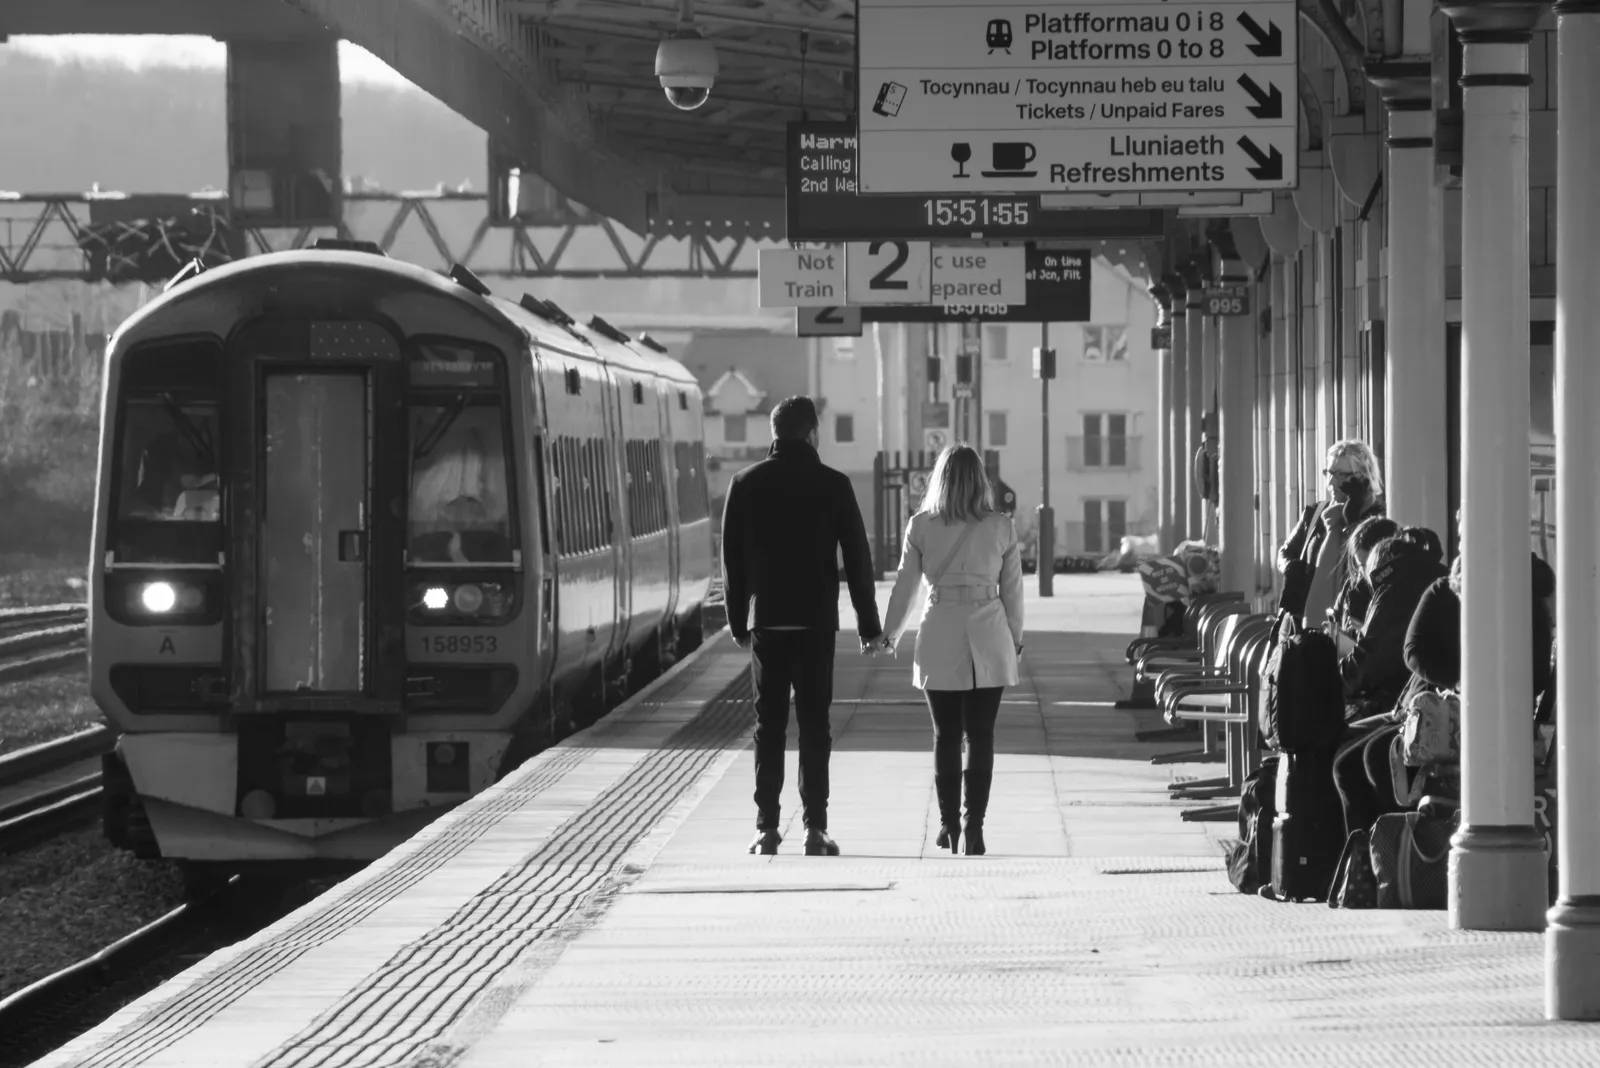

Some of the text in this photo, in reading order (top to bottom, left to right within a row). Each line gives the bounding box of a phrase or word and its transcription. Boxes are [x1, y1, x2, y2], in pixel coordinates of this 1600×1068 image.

[1025, 11, 1224, 33] Platfformau 0 i 8
[1031, 39, 1224, 60] Platforms 0 to 8
[920, 77, 1225, 98] Tocynnau / Tocynnau heb eu talu
[1016, 102, 1225, 121] Tickets / Unpaid Fares
[801, 133, 857, 149] Warm
[1110, 135, 1224, 156] Lluniaeth
[801, 155, 851, 173] Calling
[1050, 162, 1225, 183] Refreshments
[801, 177, 857, 193] 2nd We
[924, 199, 1028, 225] 15:51:55
[798, 254, 834, 271] Not
[952, 255, 987, 270] use
[868, 242, 909, 290] 2
[1044, 255, 1057, 267] On
[785, 280, 834, 298] Train
[1209, 298, 1242, 314] 995
[159, 635, 176, 656] A
[421, 635, 498, 653] 158953
